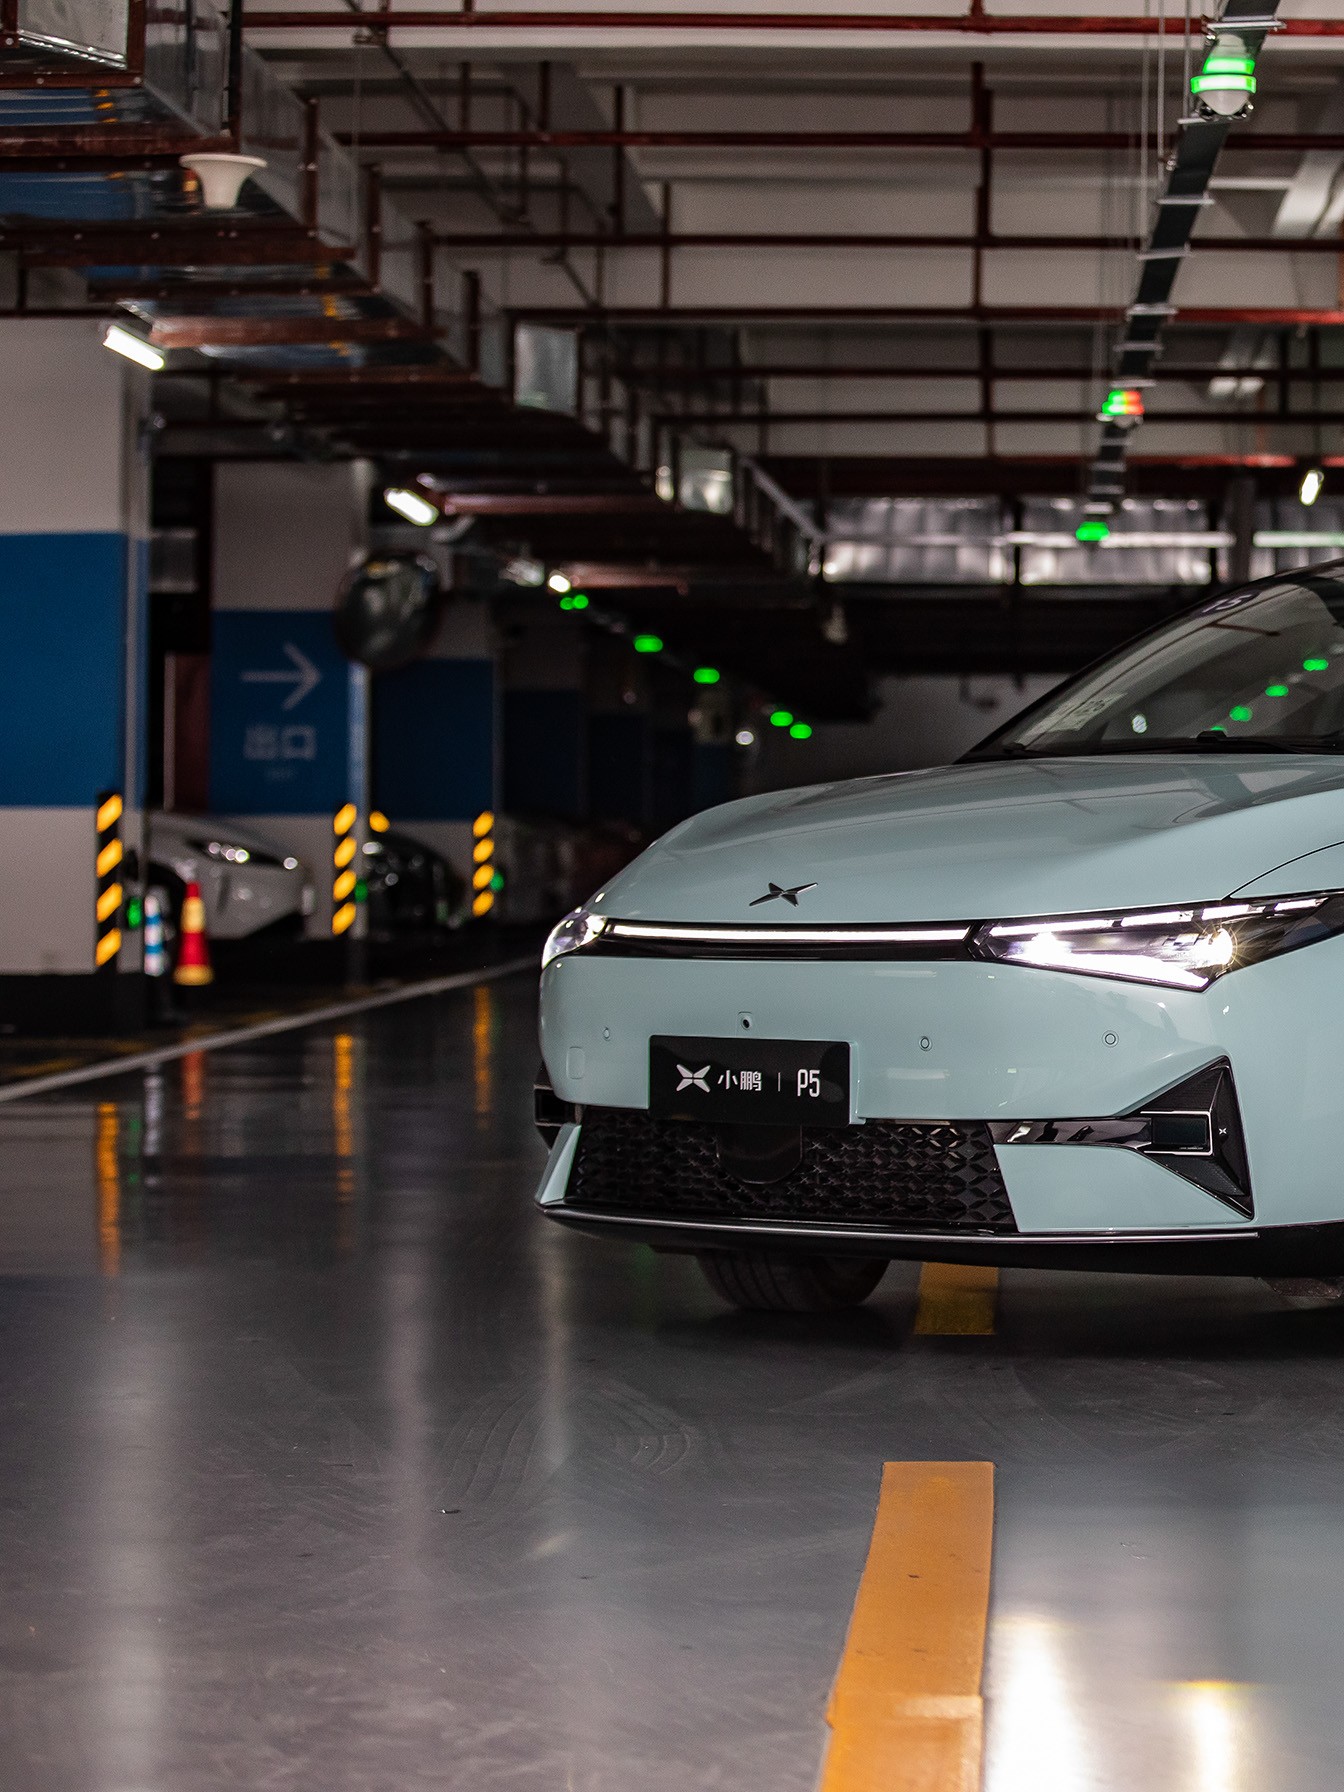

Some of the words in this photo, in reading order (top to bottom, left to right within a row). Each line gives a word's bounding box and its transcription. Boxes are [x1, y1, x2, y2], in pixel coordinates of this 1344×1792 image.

[244, 724, 317, 760] 出口
[716, 1069, 763, 1092] 小鹏
[796, 1068, 821, 1098] P5
